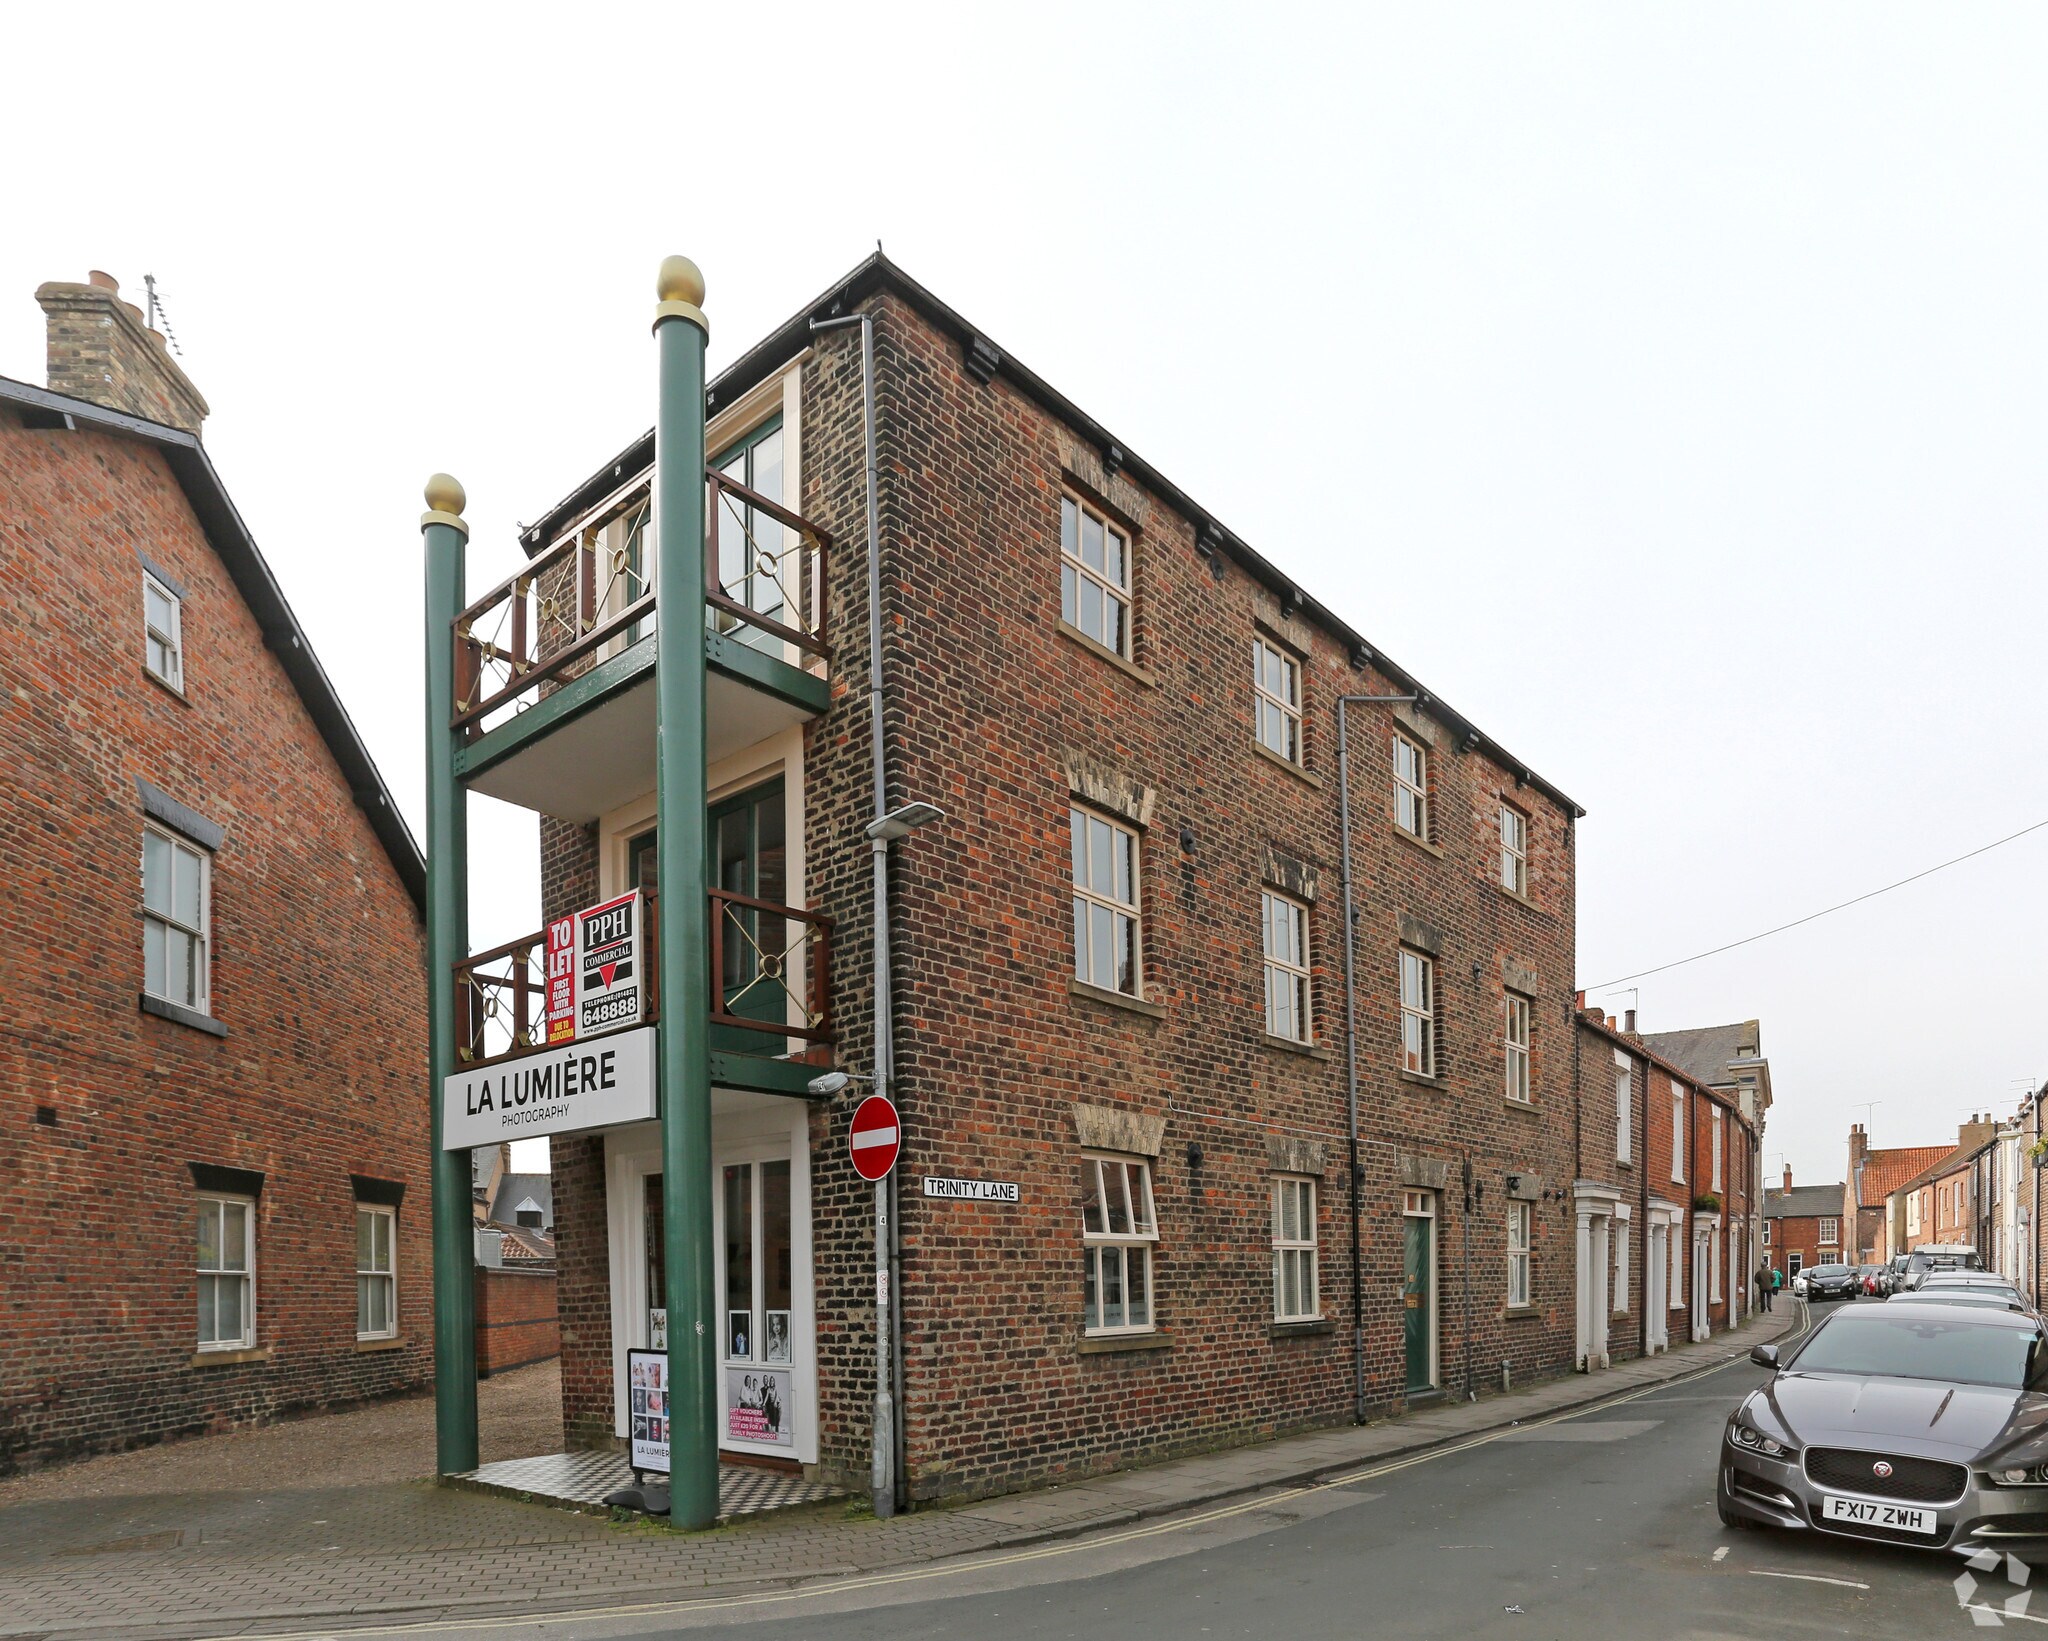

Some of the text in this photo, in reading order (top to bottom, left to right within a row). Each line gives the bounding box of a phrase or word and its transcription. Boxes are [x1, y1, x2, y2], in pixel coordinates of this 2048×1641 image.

[551, 919, 571, 950] TO
[588, 907, 627, 947] PPH
[549, 946, 573, 979] LET
[585, 945, 630, 968] COMMERCIAL
[552, 987, 570, 1001] FLOOR
[553, 977, 569, 991] FIRST
[549, 1006, 574, 1022] PARKING
[553, 997, 569, 1010] WITH
[583, 996, 637, 1026] 648888
[554, 1019, 569, 1032] DUE TO
[467, 1050, 616, 1116] LA LUMIÈRE
[502, 1103, 570, 1127] PHOTOGRAPHY
[928, 1179, 1015, 1199] TRINITY LANE
[740, 1408, 763, 1416] VOUCHERS
[637, 1446, 645, 1454] LA
[1834, 1500, 1923, 1528] FX17 ZWH
